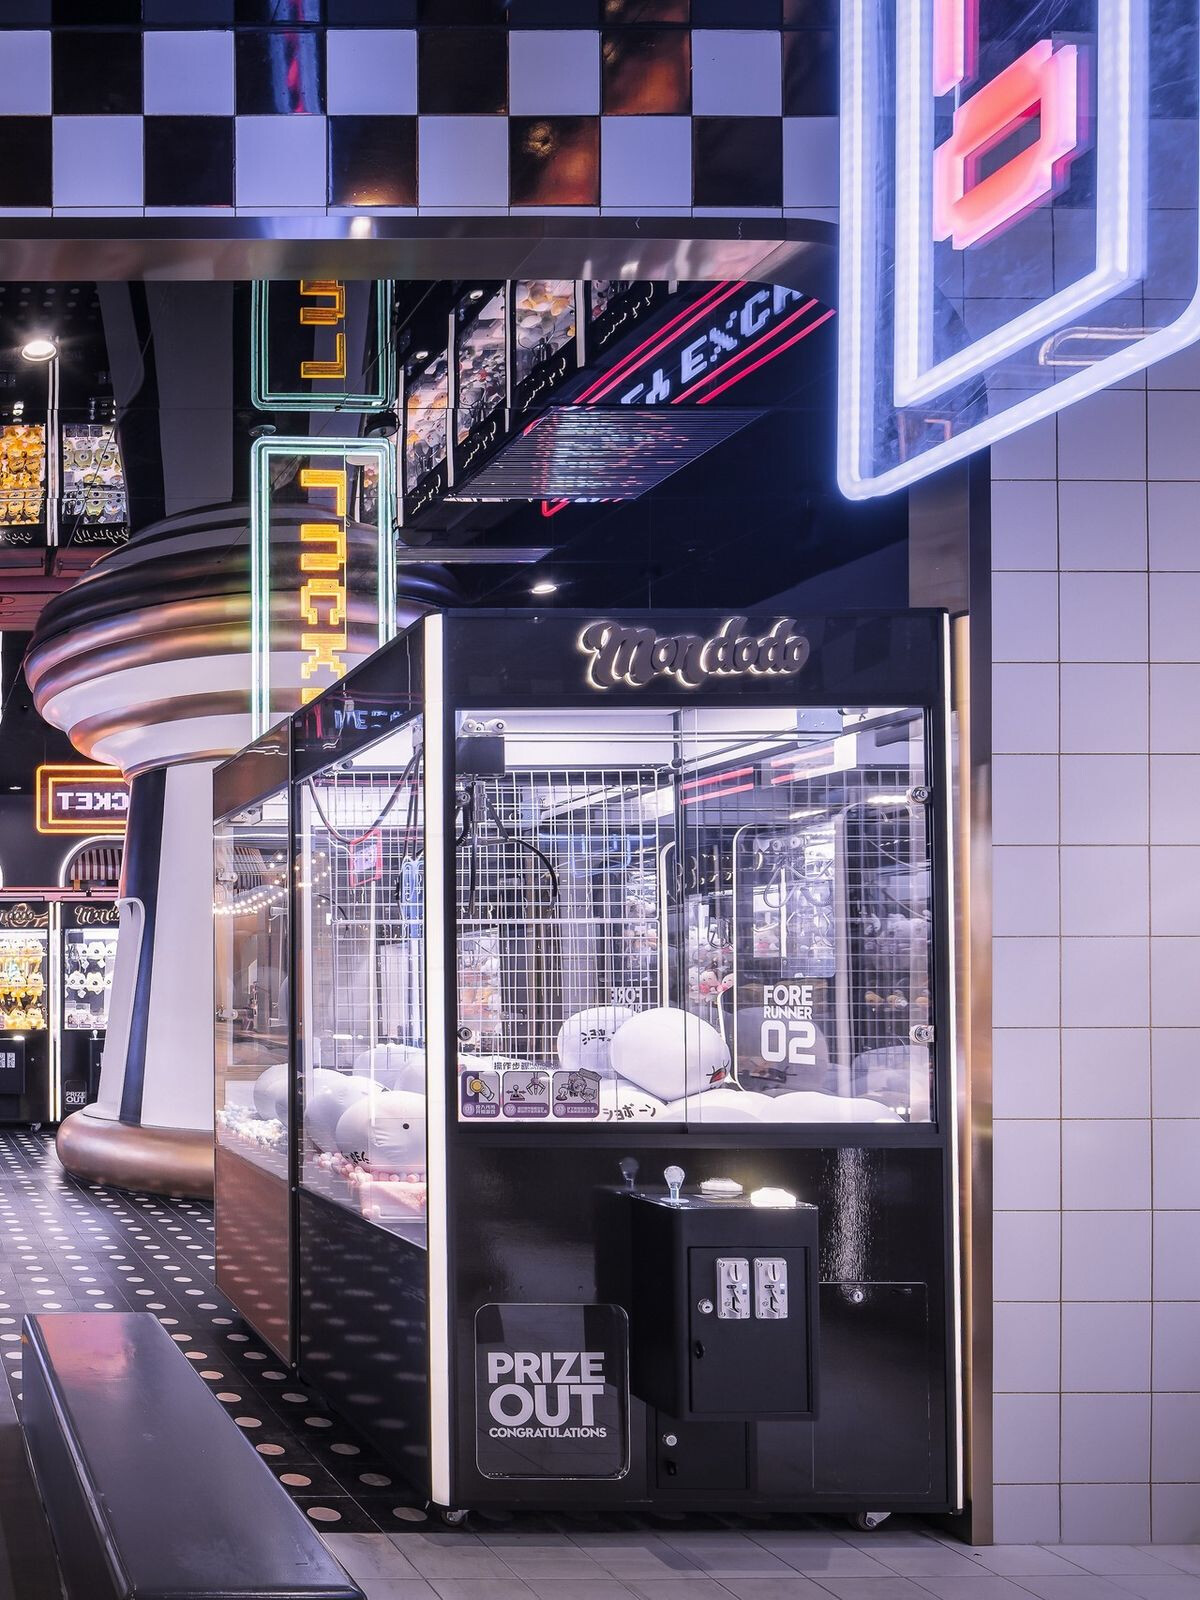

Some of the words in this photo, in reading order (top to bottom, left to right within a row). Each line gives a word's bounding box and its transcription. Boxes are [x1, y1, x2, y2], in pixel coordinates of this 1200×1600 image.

[577, 617, 810, 688] Mondodo
[763, 985, 813, 1006] FORE
[763, 1006, 813, 1019] RUNNER
[761, 1020, 816, 1065] 02
[488, 1352, 606, 1384] PRIZE
[488, 1384, 606, 1427] OUT
[488, 1427, 607, 1438] CONGRATULATIONS
